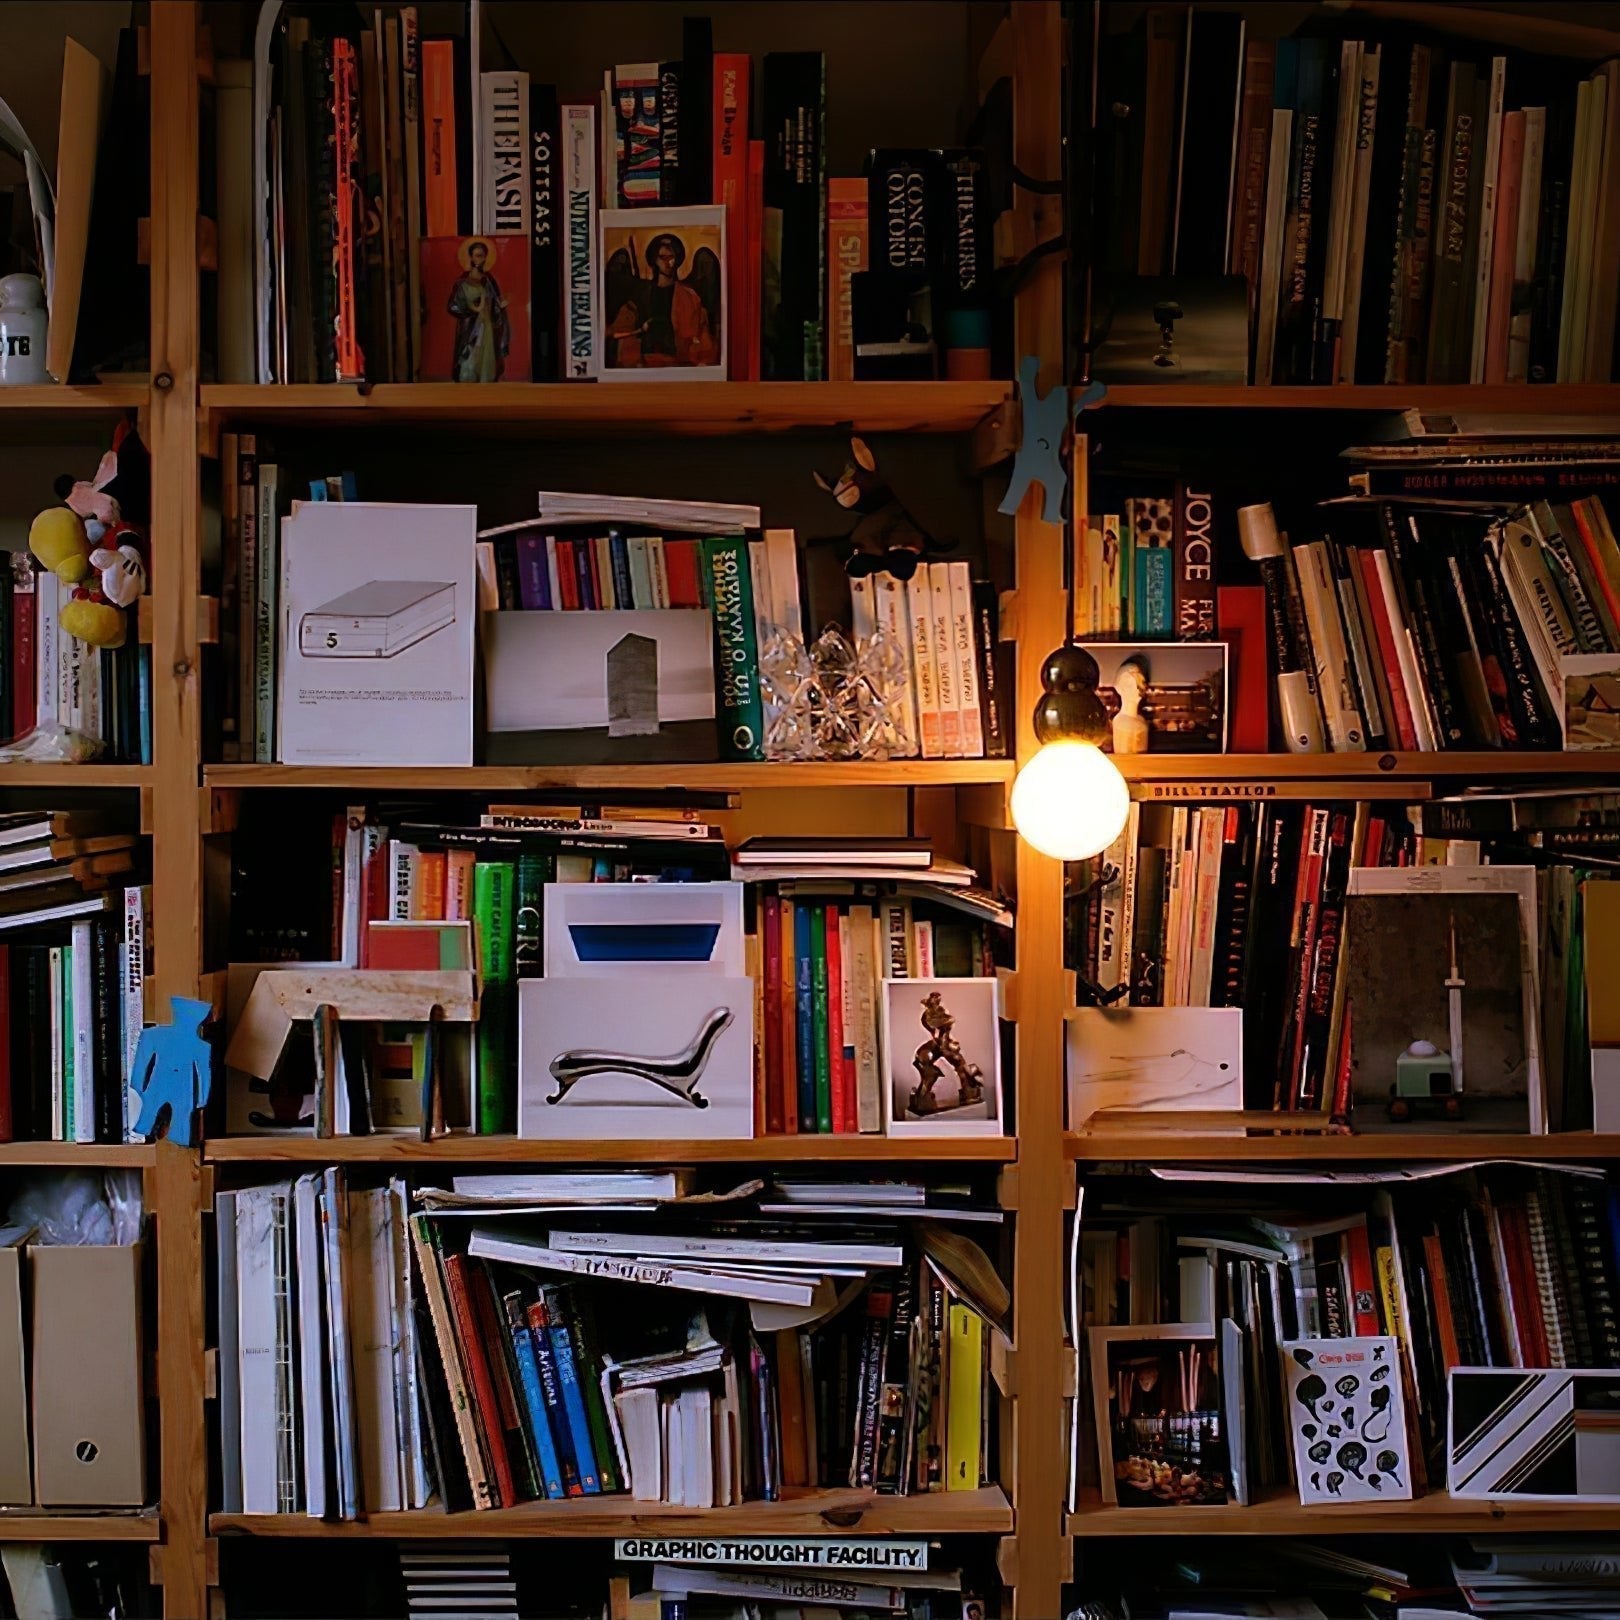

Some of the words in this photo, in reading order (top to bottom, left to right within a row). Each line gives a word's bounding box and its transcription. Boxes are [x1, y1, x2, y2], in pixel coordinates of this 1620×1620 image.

[533, 130, 551, 248] SOTTSASS
[1453, 114, 1473, 199] DESIGN
[886, 173, 906, 268] OXFORD
[906, 173, 926, 268] CONCISE
[956, 176, 977, 291] THESAURUS
[1184, 486, 1212, 581] JOYCE
[327, 632, 338, 649] 5
[623, 1540, 718, 1560] GRAPHIC
[721, 1543, 823, 1564] THOUGHT
[826, 1546, 920, 1567] FACILITY
